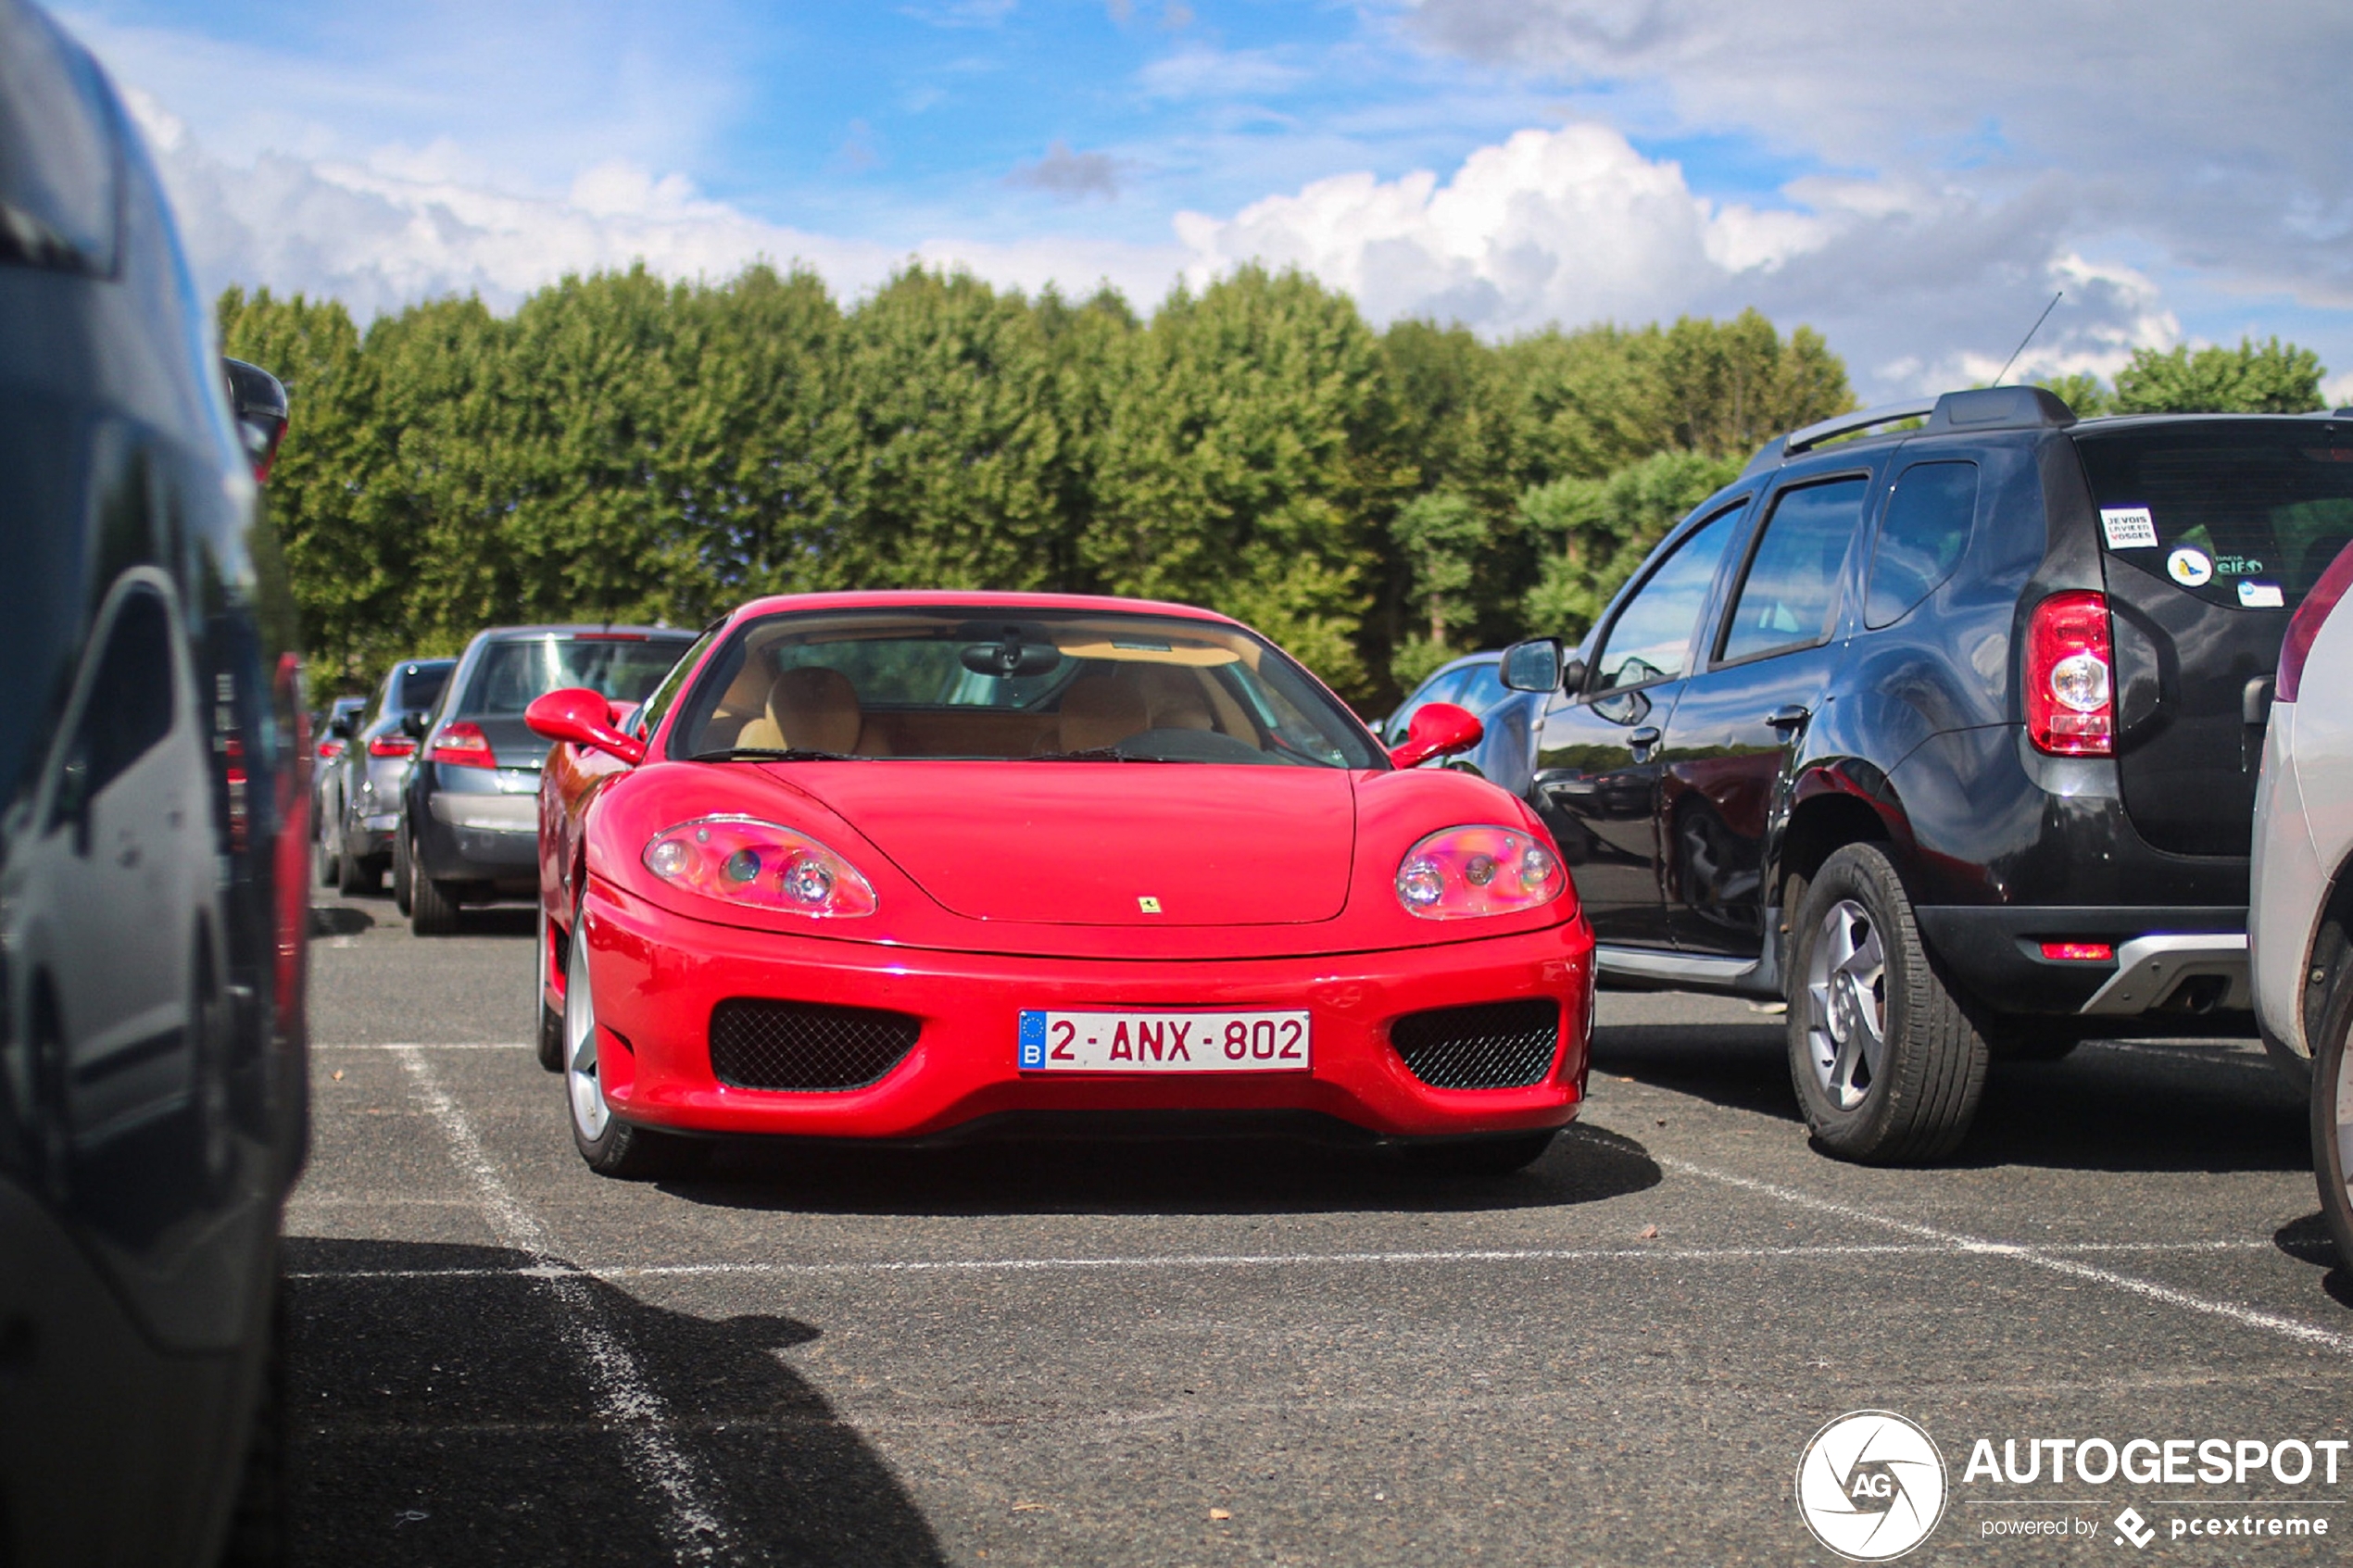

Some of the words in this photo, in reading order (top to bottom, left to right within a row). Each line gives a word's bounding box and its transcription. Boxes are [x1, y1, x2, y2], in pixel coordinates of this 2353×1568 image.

[2121, 516, 2147, 524] VOIS
[2111, 532, 2152, 541] VOSGES
[1025, 1045, 1040, 1063] B
